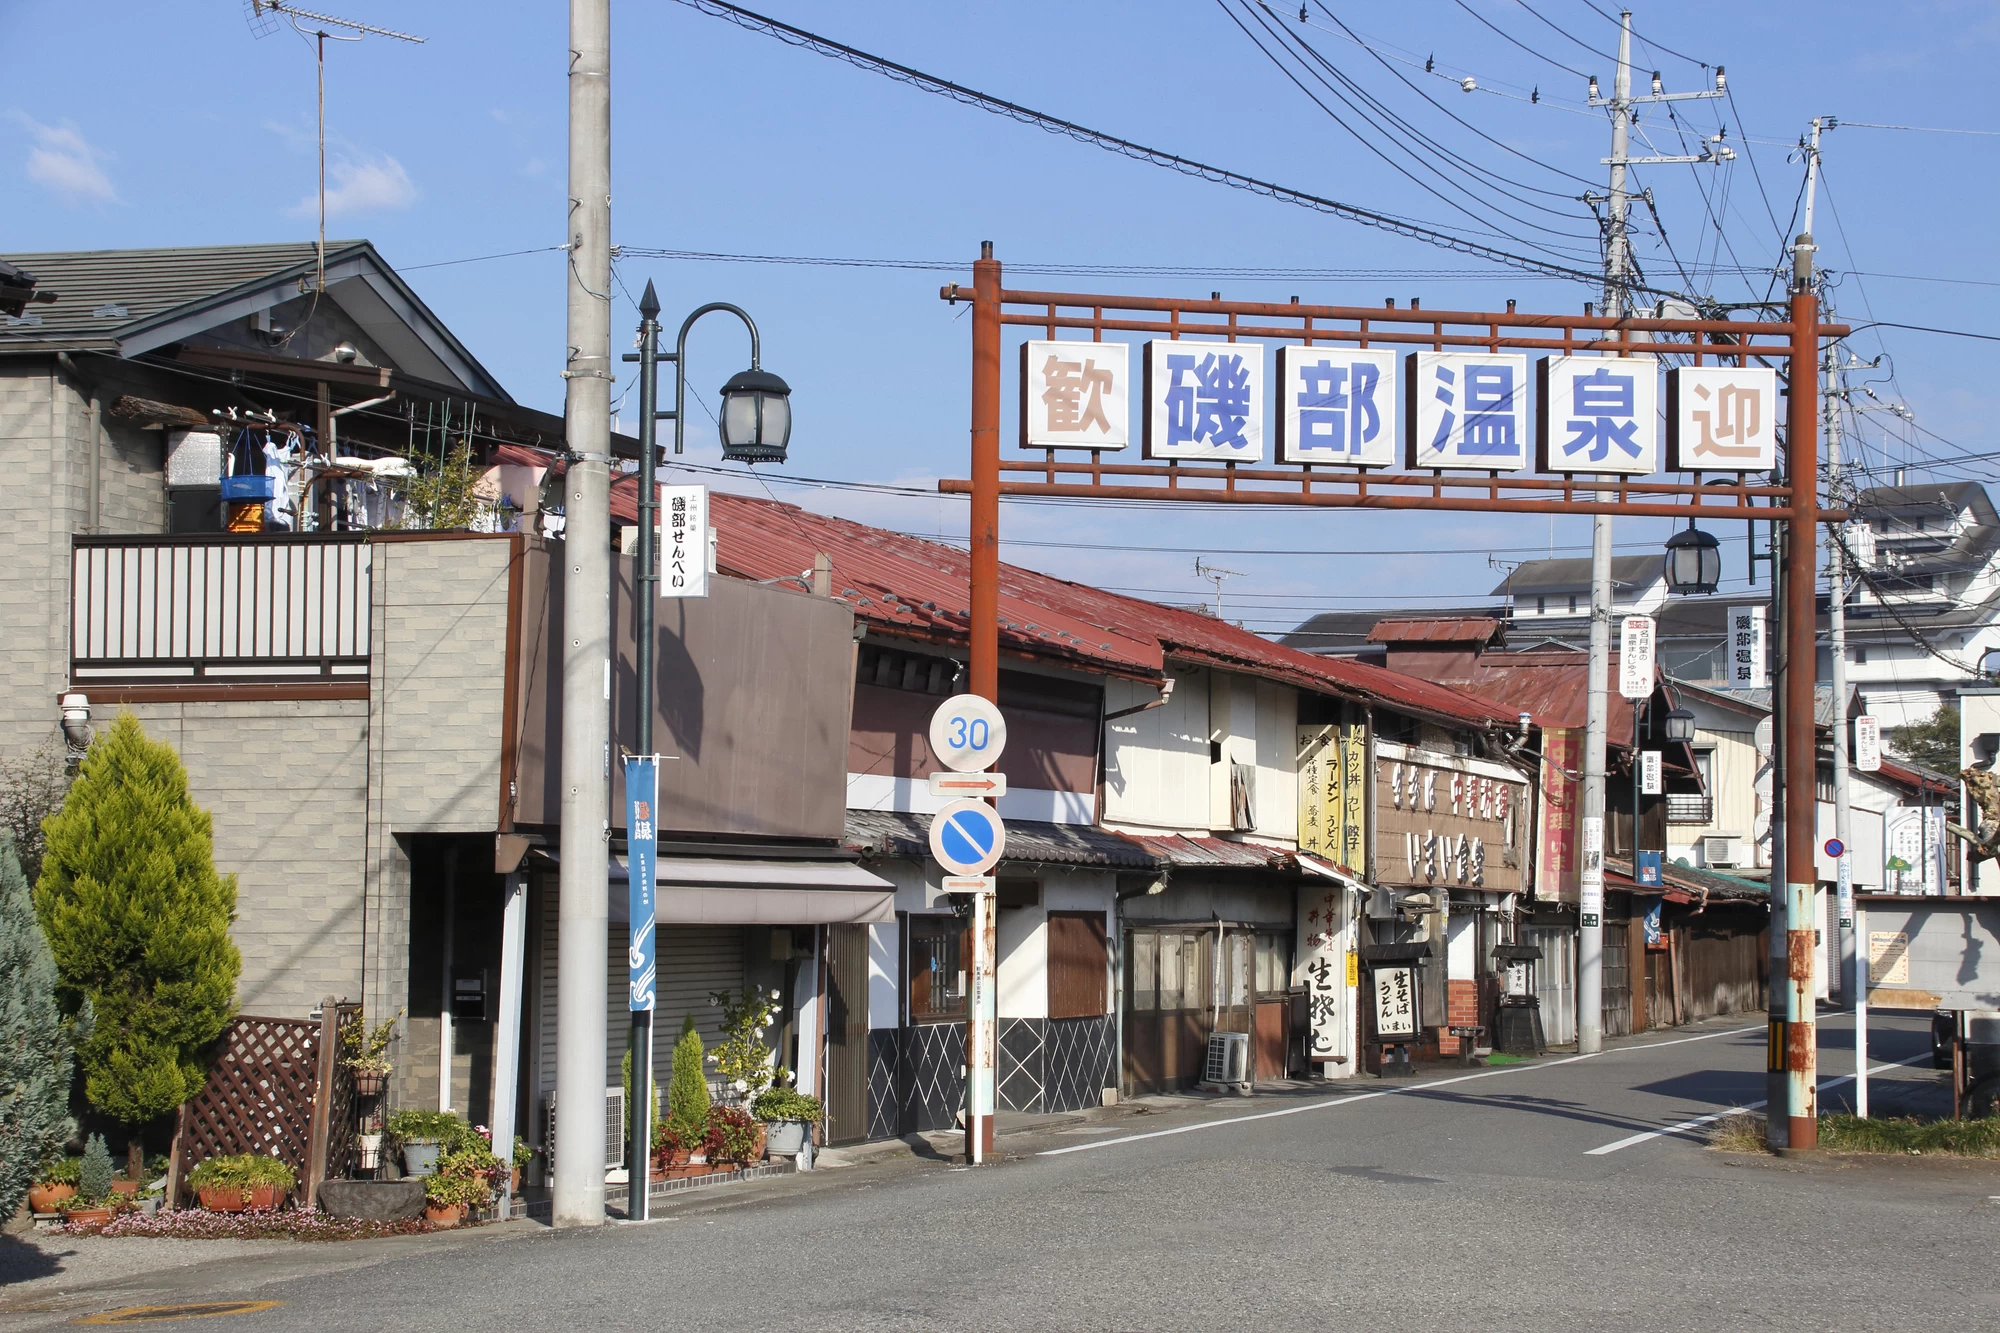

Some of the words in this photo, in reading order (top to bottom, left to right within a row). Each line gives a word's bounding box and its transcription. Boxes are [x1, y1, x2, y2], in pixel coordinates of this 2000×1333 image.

[1041, 354, 1113, 435] 歓
[1692, 382, 1762, 458] 迎
[672, 496, 686, 587] 磯部せんべい
[1627, 633, 1637, 677] 温泉まんじゅう
[1639, 629, 1649, 661] 名月堂の
[1736, 615, 1752, 680] 磯部温泉
[948, 717, 989, 751] 30
[1326, 759, 1339, 803] ラーメン
[1348, 751, 1361, 786] カツ丼
[1549, 743, 1575, 831] 中華料理
[1348, 796, 1360, 820] カレー
[1450, 772, 1510, 819] 中華料理
[1325, 815, 1339, 850] うどん
[1348, 825, 1361, 850] 餃子
[1406, 829, 1485, 886] いまい食堂
[1322, 892, 1337, 953] 中華そば
[1380, 981, 1393, 1019] うどん
[1393, 970, 1411, 1015] 生そば
